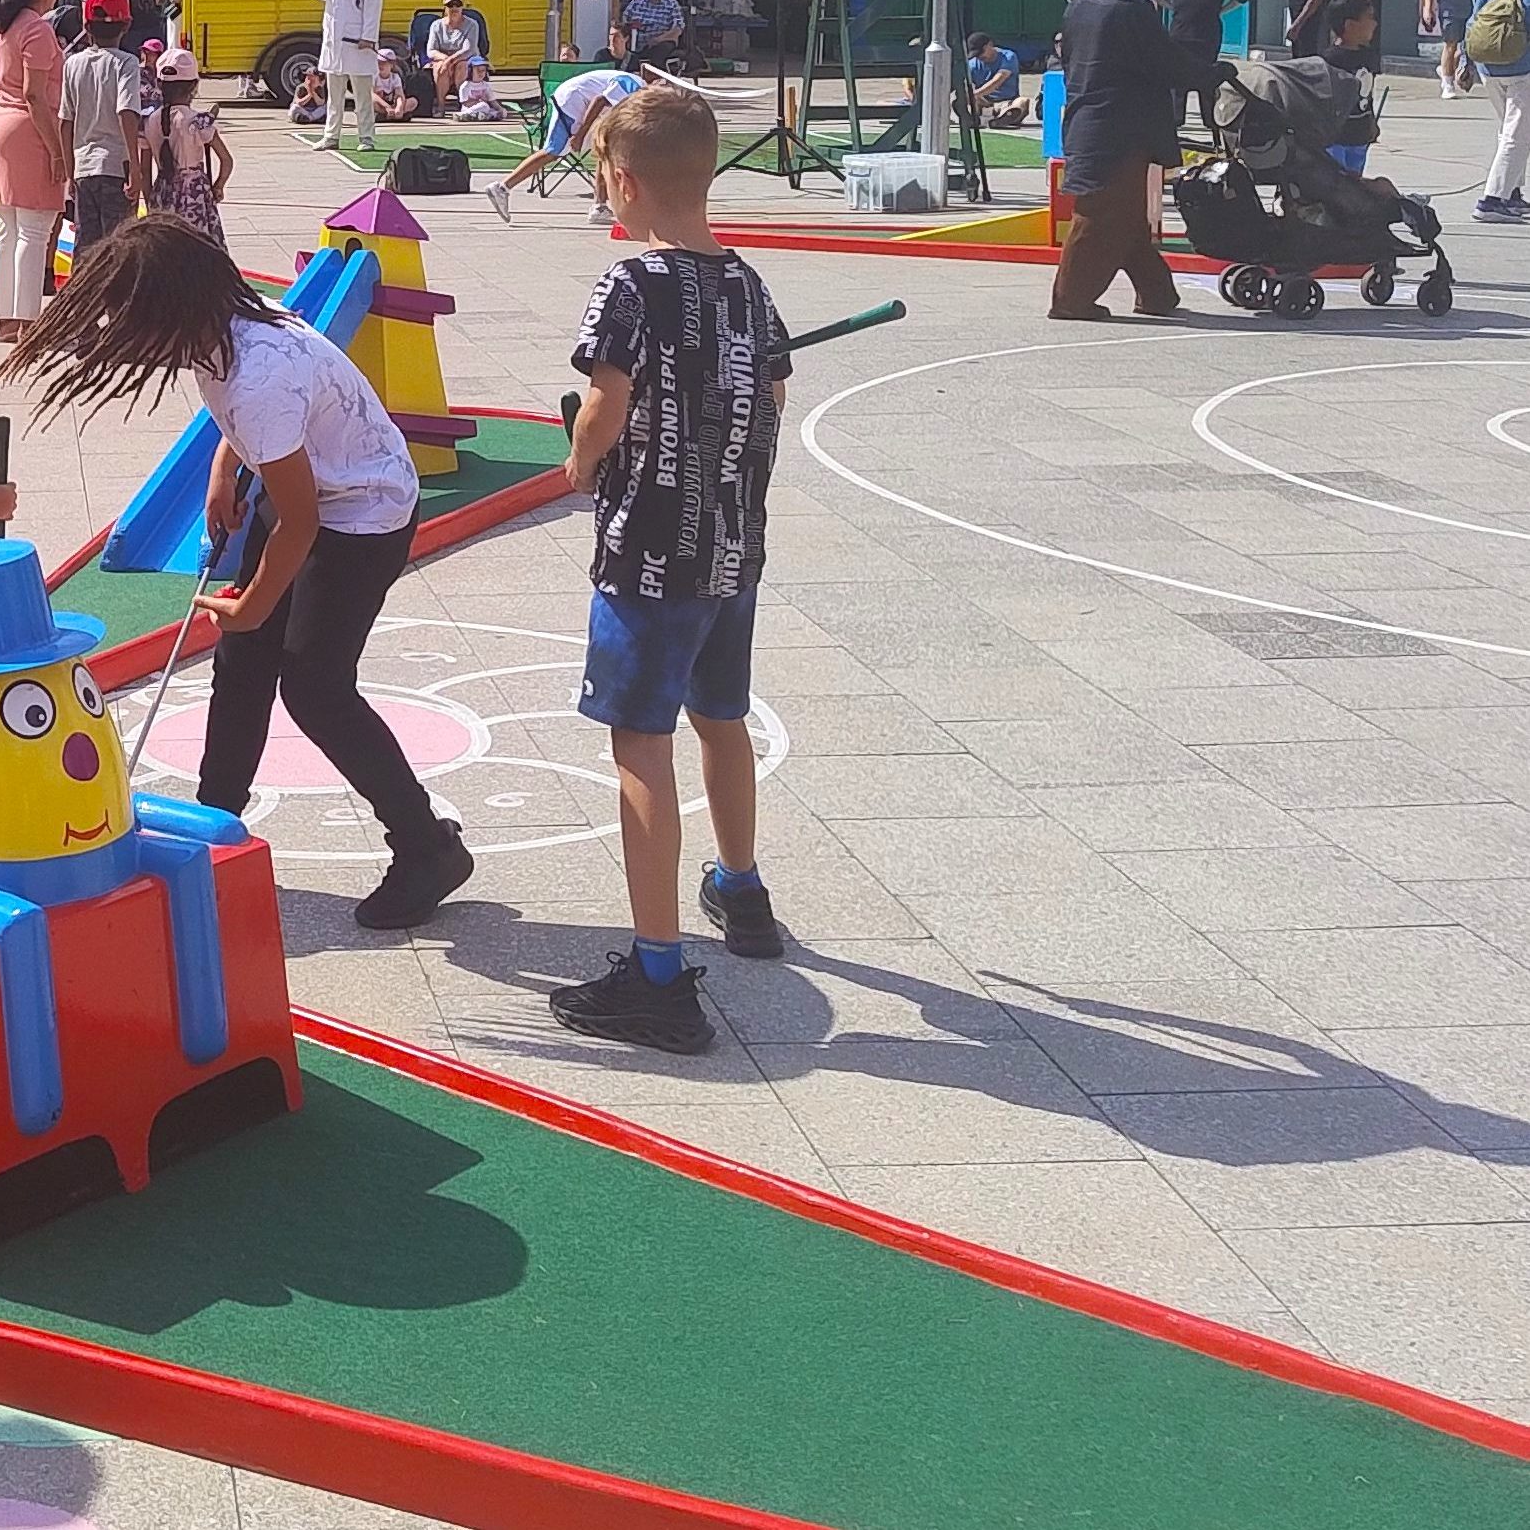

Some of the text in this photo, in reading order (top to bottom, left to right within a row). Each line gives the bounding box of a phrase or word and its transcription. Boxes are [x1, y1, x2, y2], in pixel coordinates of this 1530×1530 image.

[655, 341, 679, 488] BEYOND EPIC
[719, 330, 755, 485] WORLDWIDE
[676, 441, 702, 560] WORLDWIDE
[639, 549, 668, 599] EPIC
[720, 537, 745, 599] WIDE
